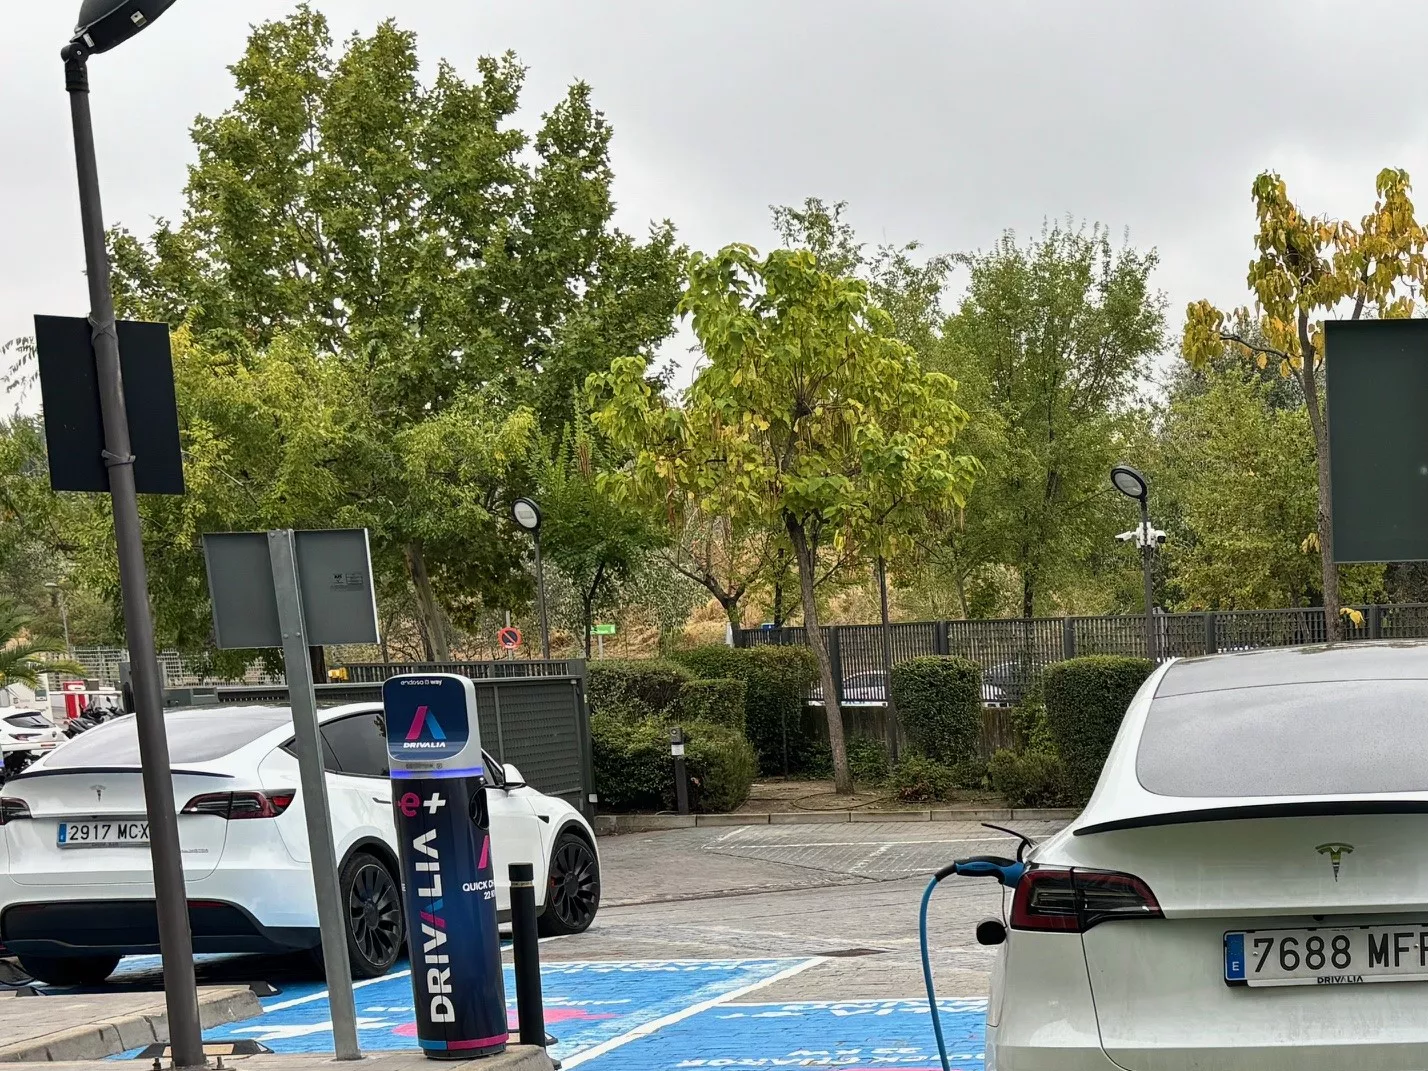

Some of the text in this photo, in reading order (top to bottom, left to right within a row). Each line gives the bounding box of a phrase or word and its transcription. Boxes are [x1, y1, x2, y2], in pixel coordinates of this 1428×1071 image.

[403, 741, 447, 749] DRIVALIA
[69, 823, 112, 841] 2917
[117, 823, 149, 839] MCX
[462, 880, 488, 892] QUICK
[412, 828, 456, 1024] DRIVALIA
[1253, 934, 1352, 974] 7688
[1231, 960, 1241, 972] E
[1316, 974, 1364, 985] DRIVALIA
